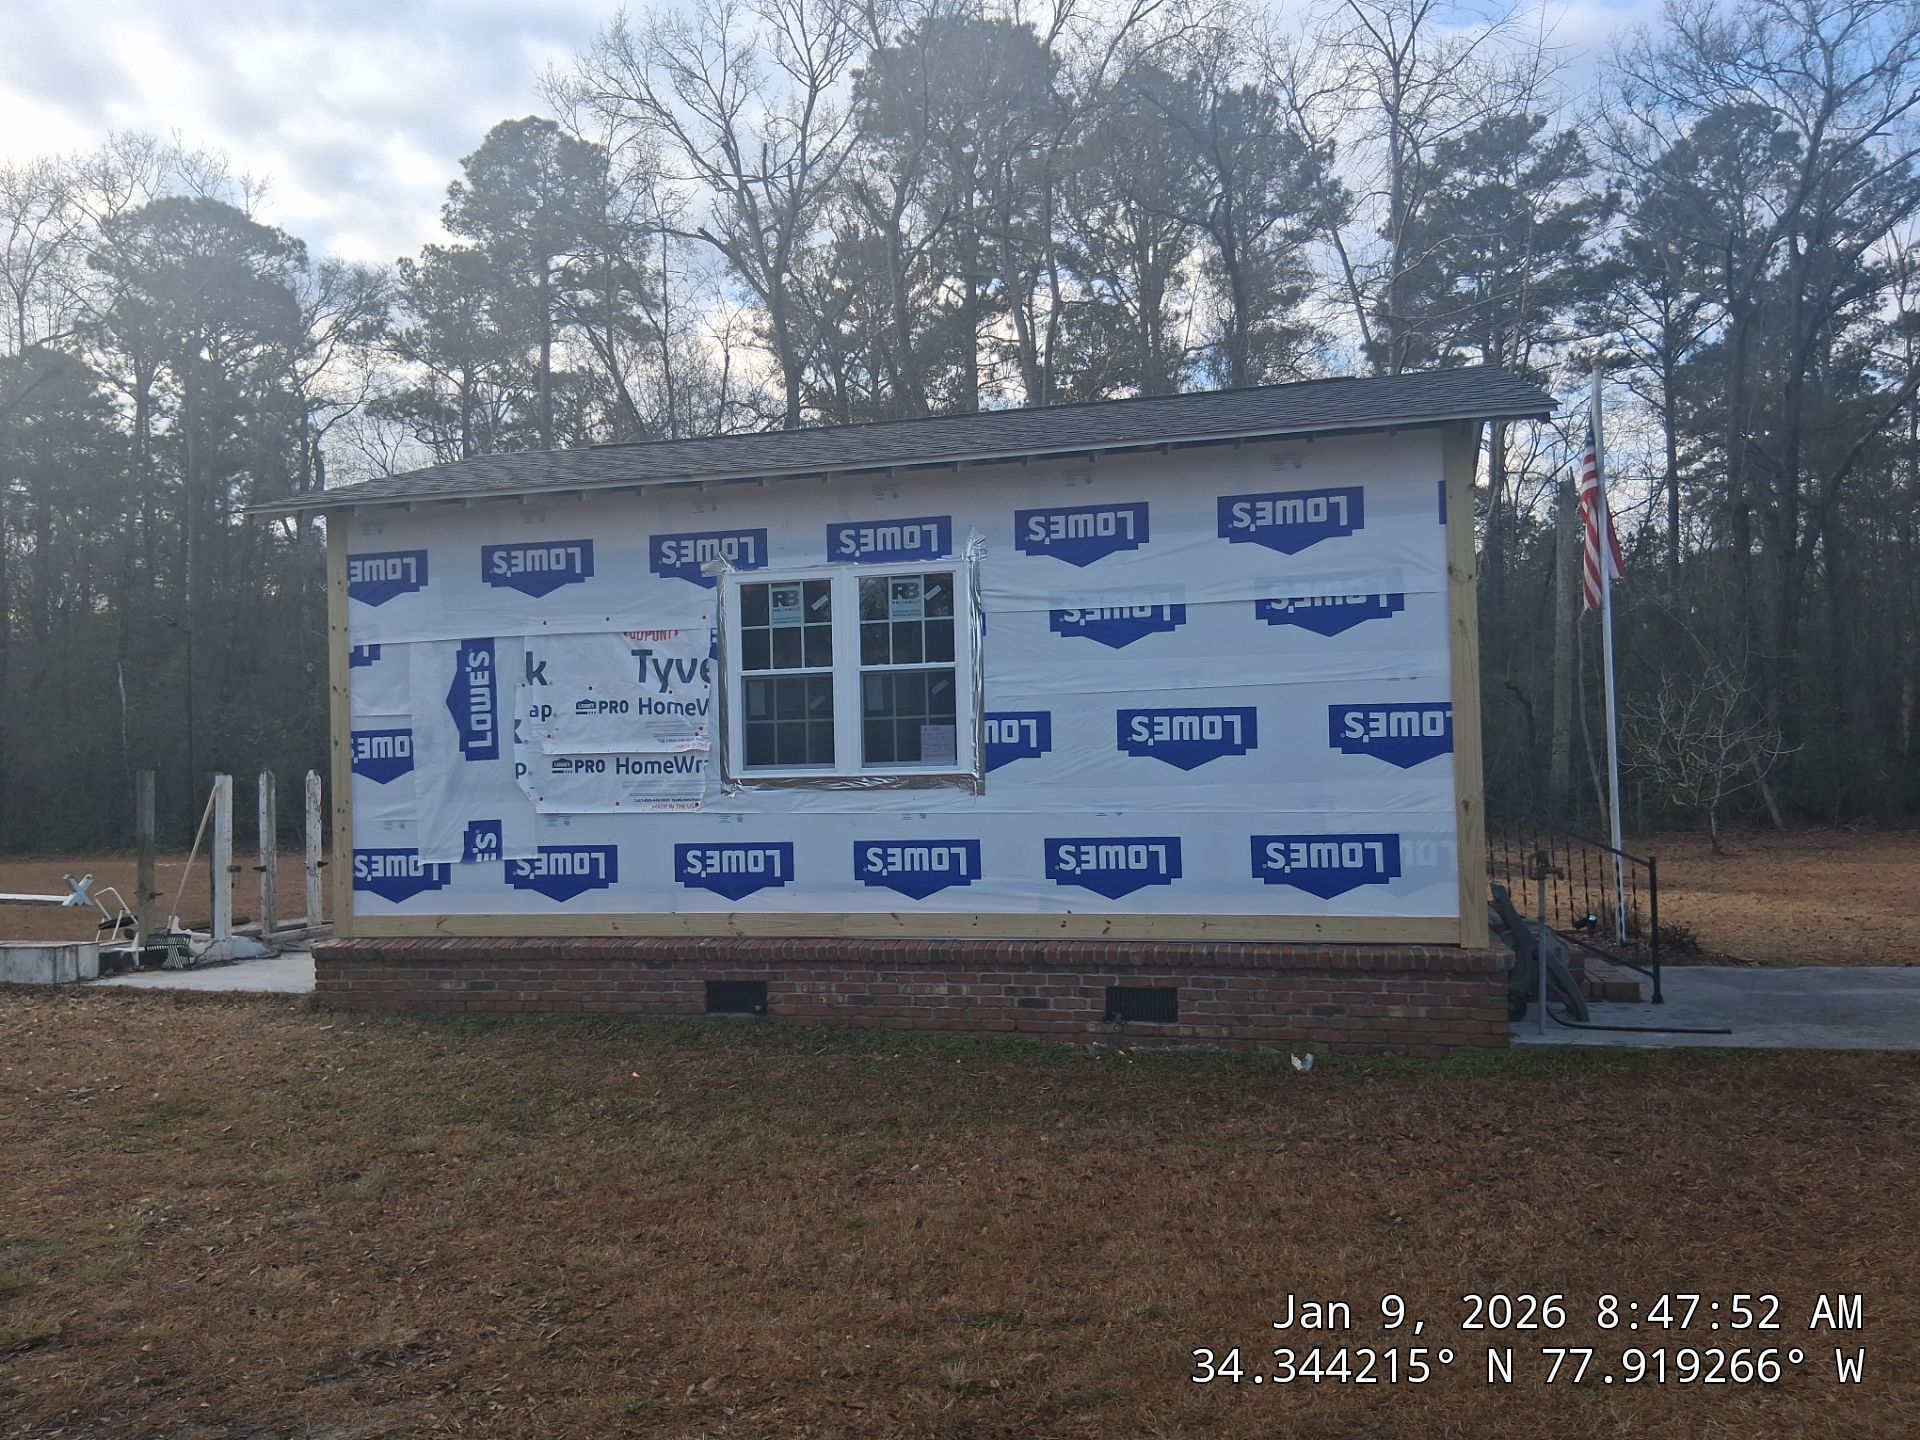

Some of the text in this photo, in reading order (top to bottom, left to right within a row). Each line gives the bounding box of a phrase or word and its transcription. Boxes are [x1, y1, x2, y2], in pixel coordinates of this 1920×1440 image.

[1029, 510, 1135, 544] LOWE'S
[1232, 496, 1348, 531] LOWE'S
[661, 536, 755, 568] LOWE'S
[839, 524, 938, 557] LOWE'S
[492, 547, 582, 578] LOWE'S
[465, 651, 492, 748] LOWE'S
[598, 700, 629, 714] PRO
[1131, 714, 1242, 746] LOWE'S
[1344, 711, 1453, 742] OWE'S
[574, 759, 606, 773] PRO
[516, 853, 605, 879] LOWE'S
[686, 849, 781, 877] LOWE'S
[866, 847, 967, 876] LOWE'S
[1059, 844, 1167, 875] LOWE'S
[1267, 842, 1384, 873] LOWE'S
